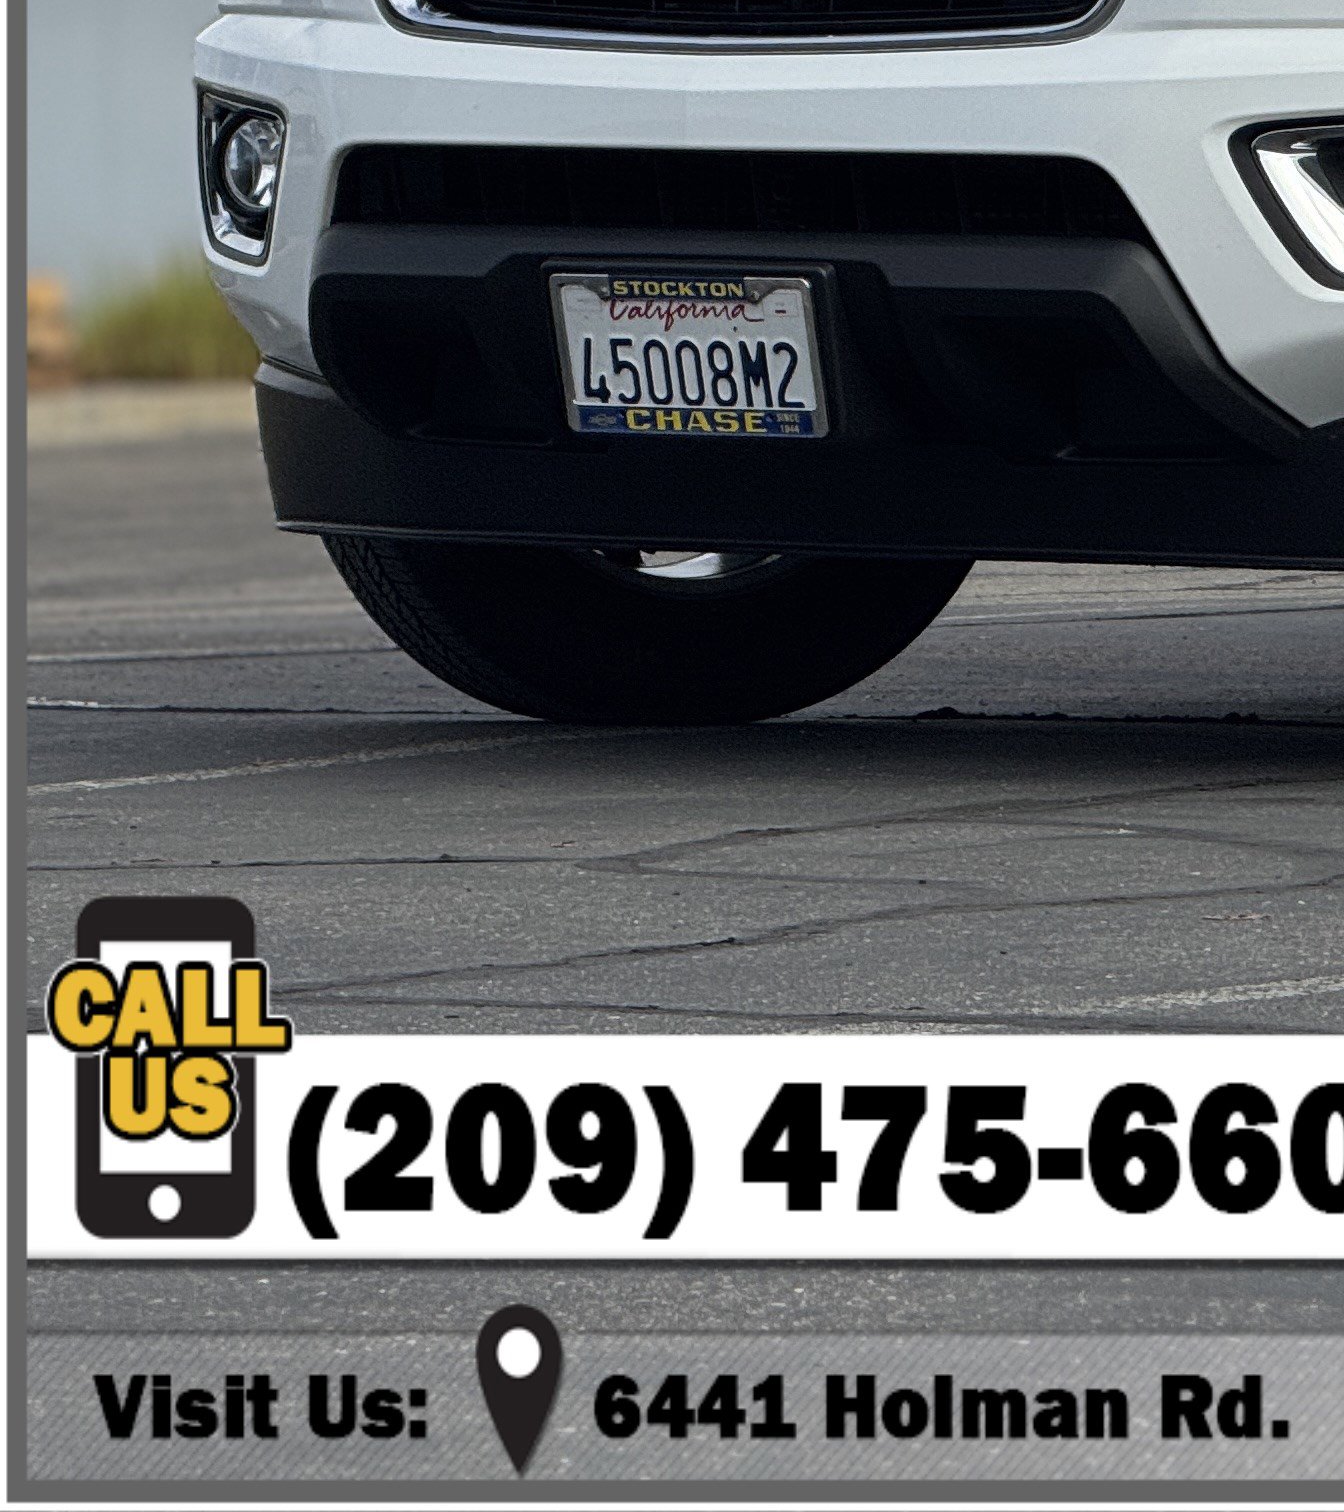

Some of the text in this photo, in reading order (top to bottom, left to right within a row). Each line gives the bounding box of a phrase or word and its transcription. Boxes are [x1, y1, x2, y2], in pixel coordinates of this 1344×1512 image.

[613, 280, 744, 297] STOCKTON
[609, 298, 765, 332] California
[583, 337, 806, 409] 45008M2
[625, 408, 768, 433] CHASE
